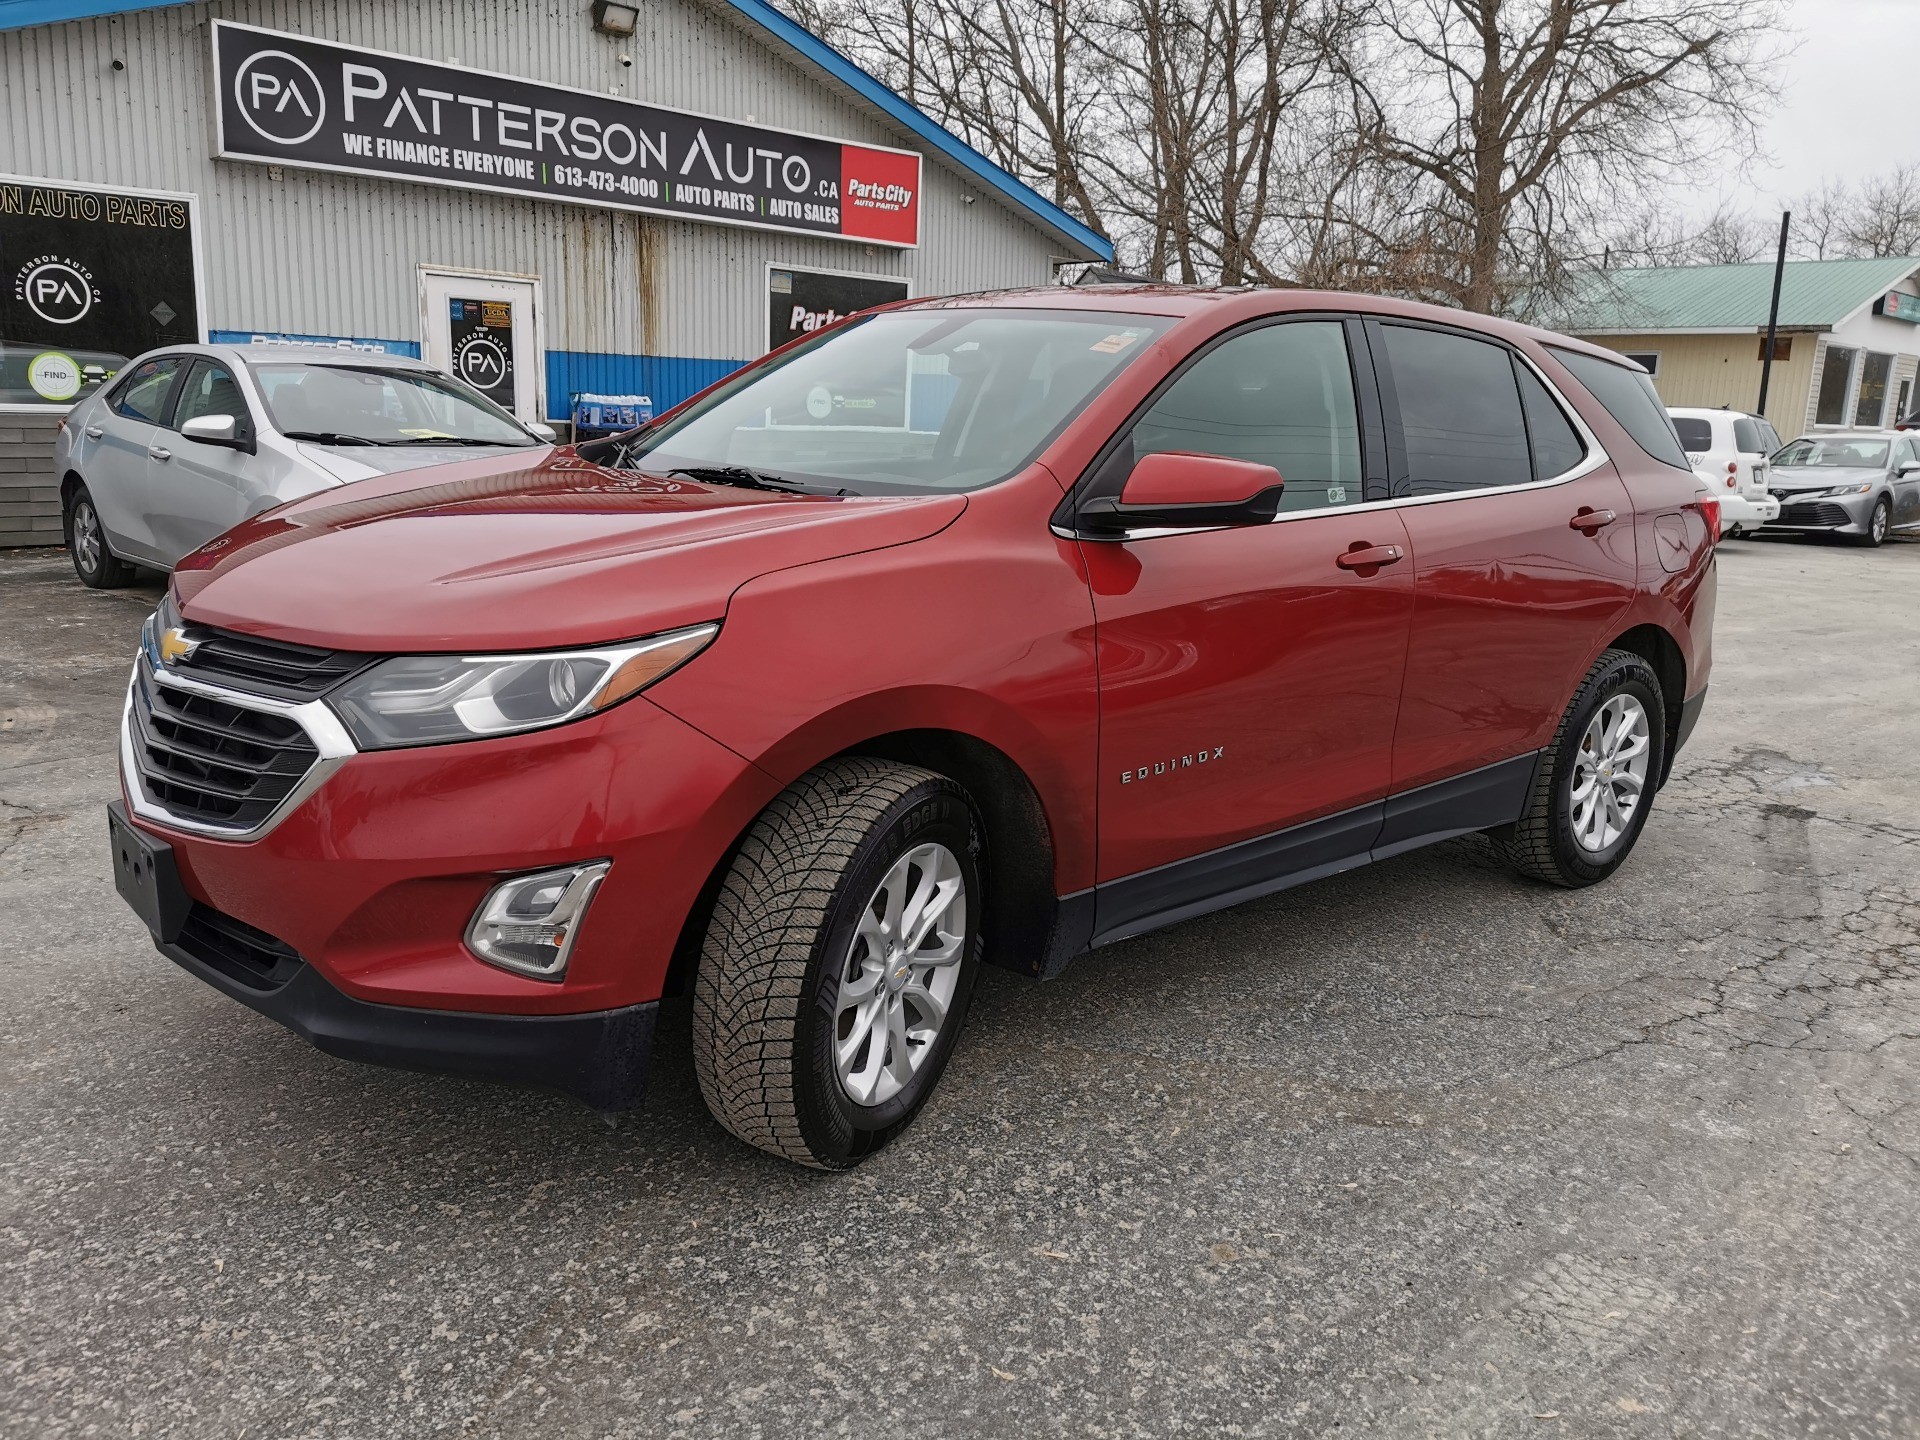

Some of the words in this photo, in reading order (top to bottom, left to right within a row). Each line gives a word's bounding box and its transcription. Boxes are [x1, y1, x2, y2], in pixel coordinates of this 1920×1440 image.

[251, 72, 312, 117] PA
[342, 62, 667, 171] PATTERSON
[679, 127, 811, 193] AUTO
[343, 132, 373, 157] WE
[376, 137, 450, 167] FINANCE
[453, 149, 534, 180] EVERYONE
[554, 164, 659, 199] 613-473-4000
[675, 183, 711, 206] AUTO
[713, 189, 755, 213] PARTS
[769, 198, 801, 219] AUTO
[803, 202, 839, 225] SALES
[29, 188, 100, 221] AUTO
[106, 195, 186, 229] PARTS
[854, 199, 874, 208] AUTO
[875, 201, 900, 211] PARTS
[15, 254, 58, 300] PATTERSON
[64, 257, 93, 280] AUTO
[453, 332, 484, 370] PATTERSON
[488, 334, 508, 353] AUTO
[44, 371, 67, 380] FIND
[1120, 746, 1224, 785] EQUINOX
